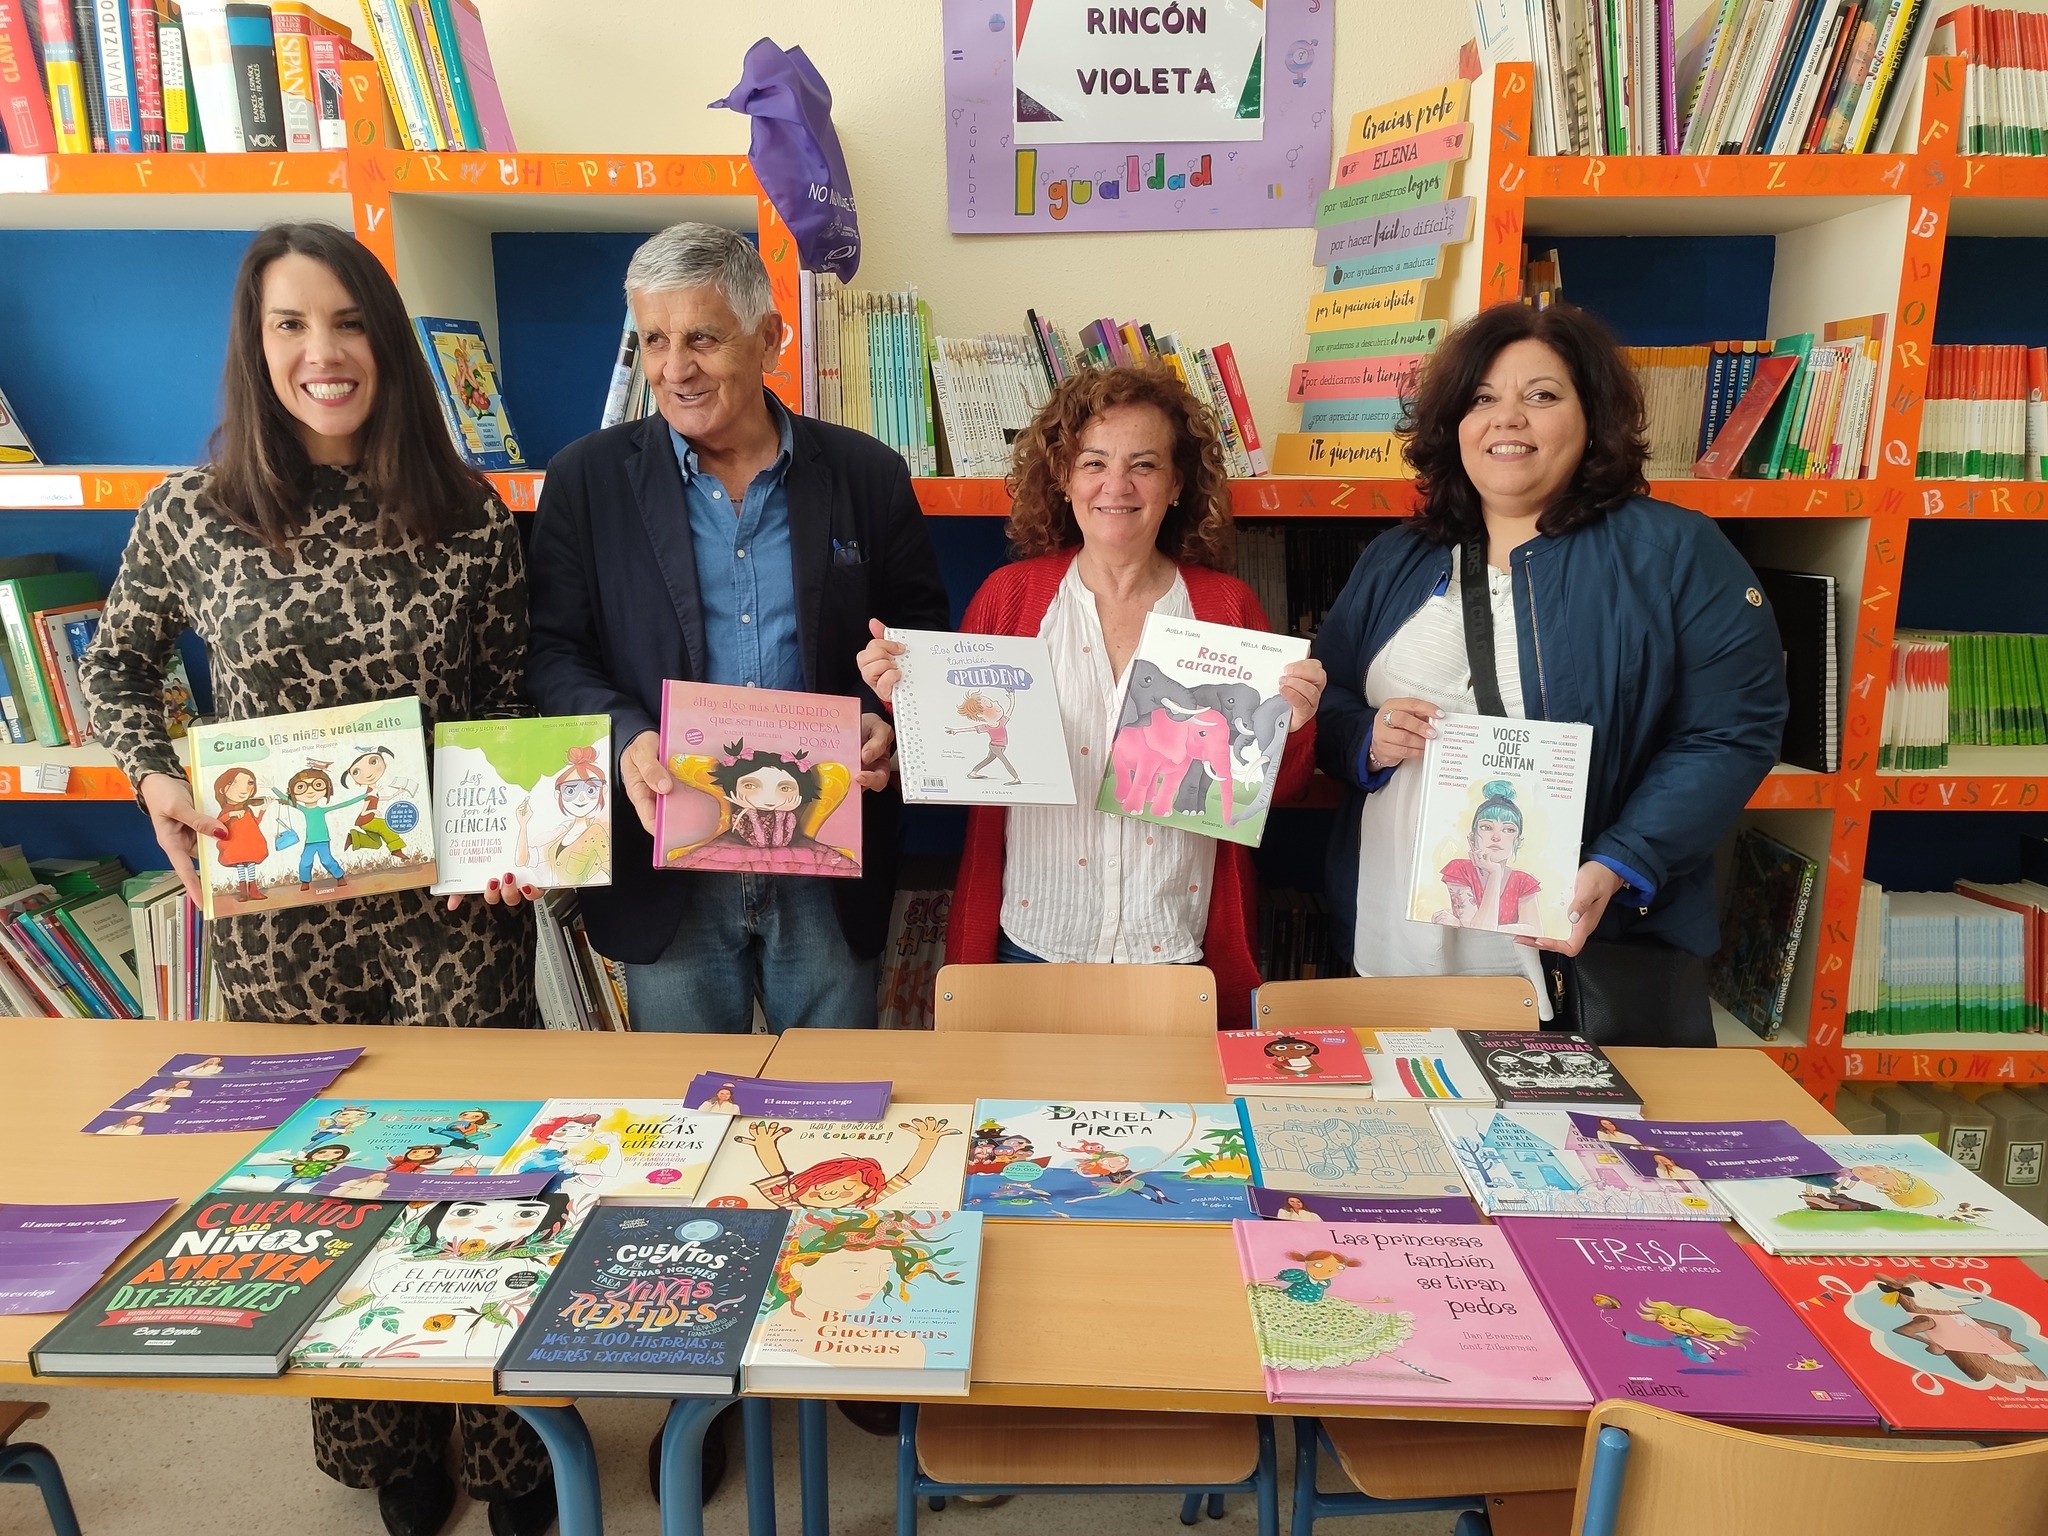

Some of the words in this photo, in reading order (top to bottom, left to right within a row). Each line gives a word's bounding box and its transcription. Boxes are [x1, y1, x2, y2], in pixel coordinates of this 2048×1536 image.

[1086, 1, 1206, 35] RINCÓN
[104, 0, 124, 93] AVANZADO
[1, 33, 21, 83] CLAVE
[1075, 67, 1216, 96] VIOLETA
[1787, 91, 1802, 125] EDUCACIÓN
[1807, 41, 1821, 73] ADAPTADA
[1821, 19, 1830, 37] AULA
[279, 37, 309, 133] SPANISH
[1362, 111, 1412, 140] Gracias
[1416, 86, 1456, 132] profe
[143, 133, 161, 144] sm
[248, 133, 278, 148] VOX
[966, 112, 978, 219] IGUALDAD
[1372, 142, 1418, 171] ELENA
[808, 182, 829, 203] NO
[1014, 149, 1213, 220] Igualdad
[1323, 202, 1338, 216] por
[1340, 193, 1369, 209] valorar
[1371, 185, 1407, 202] nuestros
[1407, 174, 1442, 200] logros
[1330, 239, 1345, 254] por
[1347, 233, 1373, 249] hacer
[1374, 218, 1401, 249] fácil
[1401, 225, 1411, 239] lo
[1412, 215, 1449, 237] difícil
[1342, 269, 1356, 283] por
[1356, 264, 1394, 279] ayudarnos
[1395, 263, 1401, 271] a
[1403, 256, 1436, 270] madurar
[1315, 307, 1329, 322] por
[1332, 299, 1342, 314] tu
[1343, 298, 1381, 319] paciencia
[1383, 289, 1416, 311] infinita
[1315, 344, 1325, 354] por
[1326, 339, 1354, 353] ayudarnos
[1361, 337, 1390, 348] descubrir
[1391, 331, 1399, 346] el
[1399, 332, 1427, 345] mundo
[1305, 376, 1319, 390] por
[1319, 374, 1361, 387] dedicarnos
[1362, 369, 1373, 384] tu
[1713, 359, 1723, 387] TEATRO
[1712, 388, 1720, 399] DE
[1315, 412, 1327, 424] por
[1328, 410, 1360, 424] apreciar
[1361, 411, 1390, 423] nuestro
[1308, 438, 1327, 461] ¡Te
[1329, 437, 1391, 467] queremos!
[953, 640, 995, 654] chicos
[1197, 646, 1238, 666] Rosa
[1240, 640, 1259, 650] NELLA
[1261, 643, 1282, 654] BOSNIA
[953, 668, 1026, 688] ¡PUEDEN!
[1176, 657, 1253, 681] caramelo
[693, 696, 719, 713] ¿Hay
[722, 698, 746, 713] algo
[749, 702, 770, 713] más
[772, 704, 840, 719] ABURRIDO
[213, 737, 265, 753] Cuando
[292, 728, 327, 742] niñas
[329, 721, 373, 736] vuelan
[375, 716, 402, 730] alto
[709, 716, 733, 728] que
[735, 717, 753, 727] ser
[756, 719, 775, 729] una
[778, 720, 840, 734] PRINCESA
[798, 736, 841, 749] ROSA?
[1492, 727, 1531, 743] VOCES
[1497, 741, 1522, 757] QUE
[1481, 753, 1535, 772] CUENTAN
[459, 768, 483, 786] Las
[446, 785, 507, 808] CHICAS
[461, 807, 480, 818] son
[482, 804, 496, 815] de
[445, 817, 507, 834] CIENCIAS
[1775, 972, 1792, 1014] GUINNESS
[1785, 940, 1799, 971] WORLD
[1792, 898, 1809, 942] RECORDS
[1802, 877, 1814, 898] 2022
[1224, 1030, 1285, 1038] TERESA
[1478, 1040, 1520, 1048] CHICAS
[1523, 1042, 1593, 1052] MODERNAS
[378, 1113, 405, 1123] Las
[409, 1114, 453, 1123] niñas
[1043, 1105, 1176, 1122] DANIELA
[1262, 1102, 1280, 1113] La
[1285, 1102, 1330, 1113] Peluca
[1334, 1104, 1348, 1113] de
[1355, 1106, 1398, 1116] LUCA
[384, 1121, 424, 1131] serán
[625, 1123, 697, 1136] CHICAS
[1071, 1122, 1153, 1138] PIRATA
[367, 1137, 412, 1146] quieran
[372, 1144, 398, 1152] ser
[621, 1140, 704, 1150] GUERRERAS
[196, 1200, 383, 1230] CUENTOS
[224, 1222, 272, 1234] PARA
[165, 1229, 334, 1258] NIÑOS
[323, 1238, 354, 1251] Que
[1329, 1229, 1369, 1246] Las
[1371, 1232, 1484, 1251] princesas
[325, 1247, 346, 1257] se
[616, 1240, 729, 1270] CUENTOS
[1404, 1250, 1496, 1270] también
[1555, 1236, 1716, 1268] TERESA
[127, 1253, 336, 1285] ATREVEN
[405, 1267, 425, 1279] EL
[432, 1265, 503, 1280] FUTURO
[607, 1263, 661, 1278] BUENAS
[666, 1266, 719, 1281] NOCHES
[1603, 1263, 1617, 1272] no
[1620, 1264, 1655, 1274] quiere
[1658, 1264, 1674, 1274] ser
[1678, 1264, 1722, 1275] princesa
[1889, 1257, 1926, 1268] DE
[1928, 1257, 1990, 1270] OSO
[391, 1280, 415, 1293] ES
[416, 1279, 498, 1294] FEMENINO
[596, 1274, 622, 1288] PARA
[1416, 1275, 1442, 1290] se
[1448, 1273, 1507, 1293] tiran
[106, 1282, 301, 1312] DIFERENTES
[605, 1276, 714, 1307] NIÑAS
[558, 1290, 746, 1333] REBELDES
[822, 1310, 903, 1326] Brujas
[1444, 1298, 1518, 1320] pedos
[542, 1331, 569, 1346] MÁS
[572, 1335, 590, 1344] DE
[592, 1331, 630, 1347] 100
[631, 1334, 710, 1349] HISTORIAS
[711, 1340, 727, 1349] DE
[816, 1324, 949, 1340] Guerreras
[527, 1347, 589, 1363] MUJERES
[592, 1348, 726, 1366] EXTRAORDINARIAS
[814, 1340, 901, 1355] Diosas
